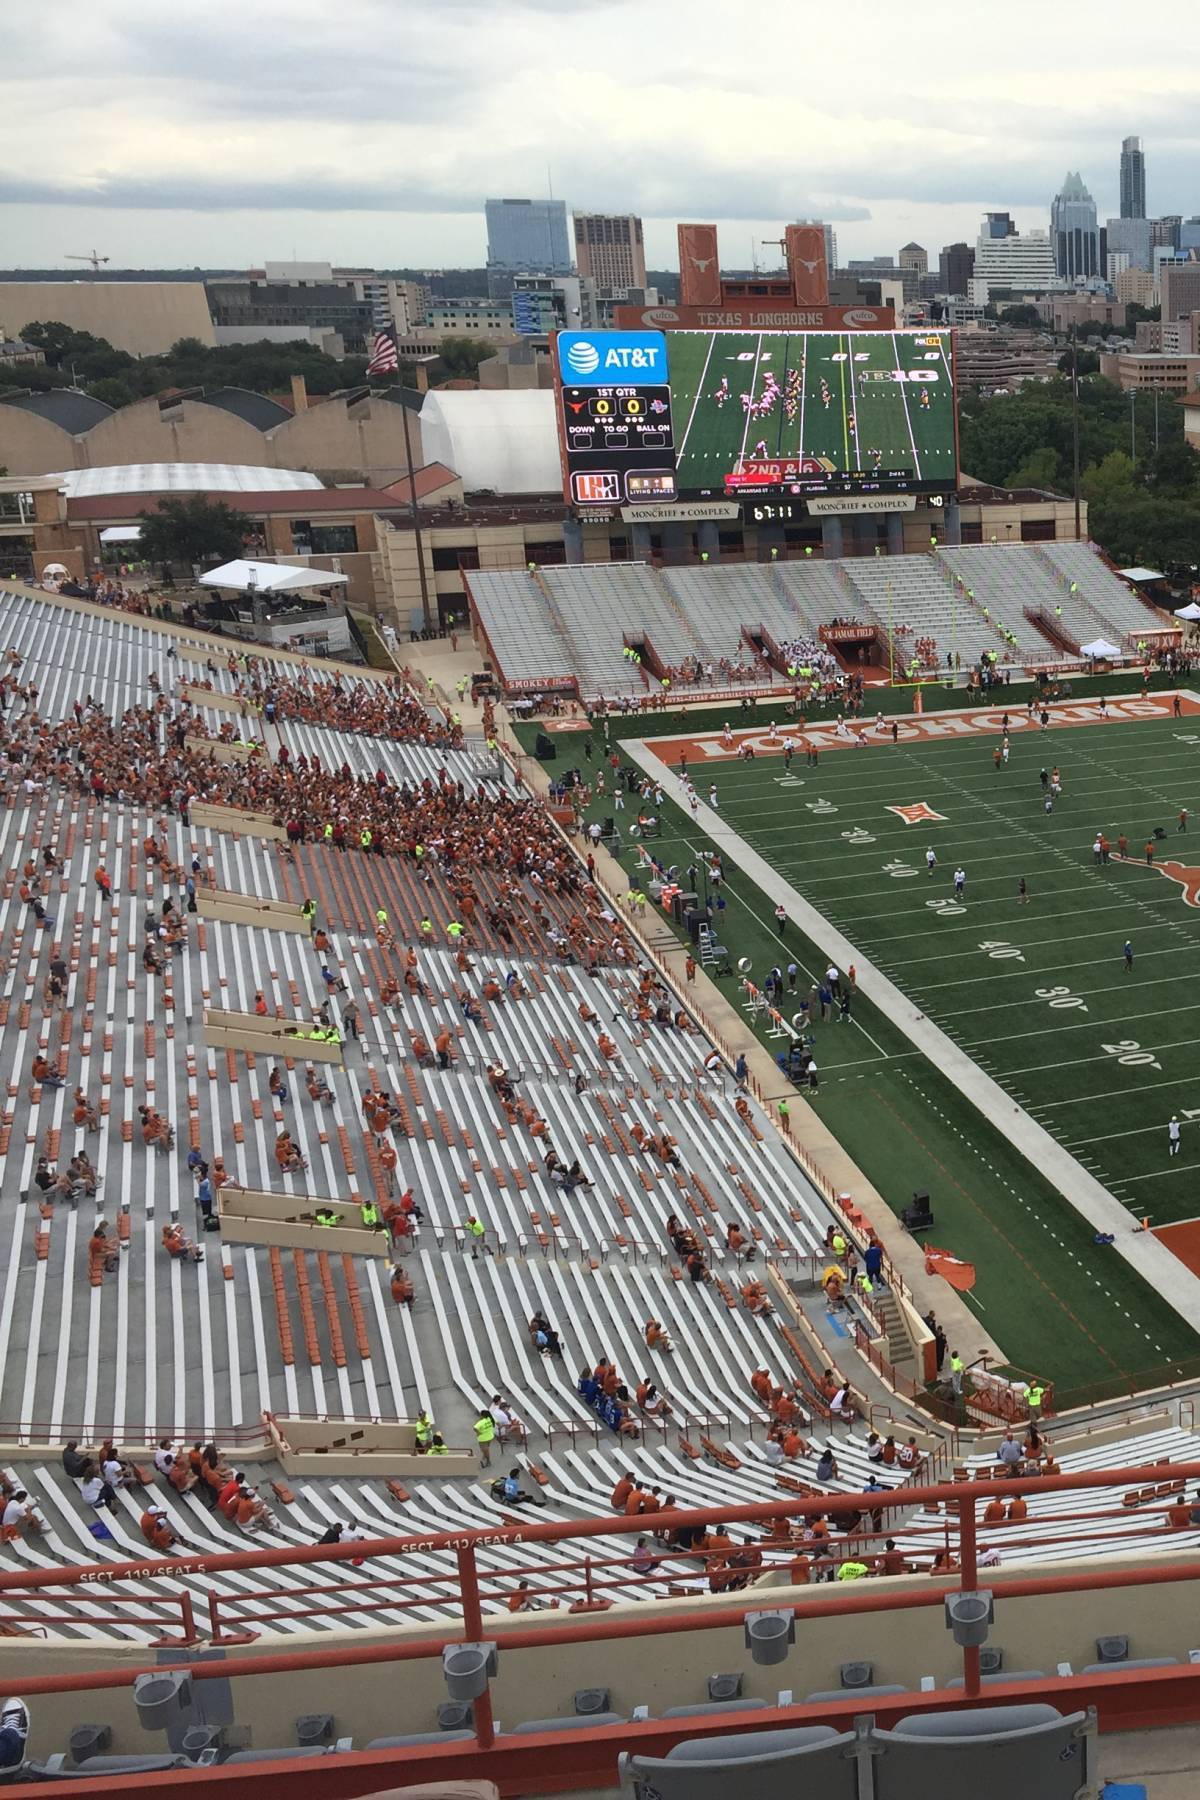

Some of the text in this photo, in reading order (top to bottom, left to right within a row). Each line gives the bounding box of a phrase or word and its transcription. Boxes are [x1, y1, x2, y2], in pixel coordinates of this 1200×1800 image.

[698, 312, 824, 326] TEXAS LONGHORNS
[604, 348, 659, 368] AT&T
[597, 388, 637, 397] 1ST QTR
[596, 400, 609, 414] 0
[627, 400, 640, 414] 0
[748, 464, 780, 474] 2ND
[816, 500, 908, 511] MONCRIEF COMPLEX
[930, 496, 943, 507] 40
[632, 508, 731, 518] MONCRIEF COMPLEX
[754, 506, 792, 520] 67:11
[857, 628, 874, 638] FIELD
[508, 678, 549, 689] SMOKEY
[694, 700, 1170, 757] LONGHORNS
[772, 774, 806, 787] 10
[840, 828, 877, 844] 30
[881, 860, 920, 878] 40
[925, 898, 968, 916] 50
[977, 941, 1022, 959] 40
[1034, 986, 1084, 1009] 30
[1100, 1040, 1155, 1066] 20
[901, 1446, 914, 1462] 20
[513, 1533, 524, 1543] 4
[197, 1563, 206, 1574] 5
